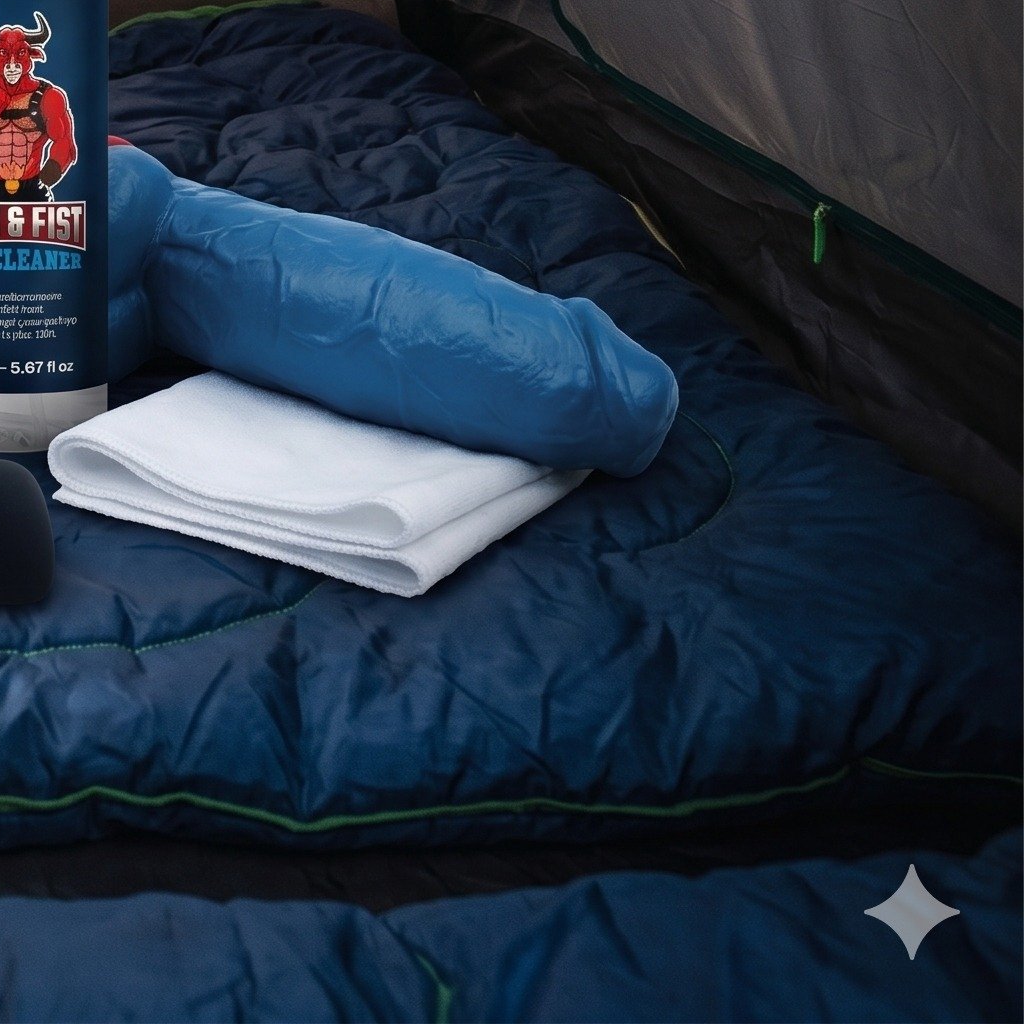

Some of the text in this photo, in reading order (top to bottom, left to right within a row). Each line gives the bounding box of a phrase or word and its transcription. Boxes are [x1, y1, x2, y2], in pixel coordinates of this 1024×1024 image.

[7, 206, 25, 237] &
[32, 205, 83, 243] FIST
[10, 361, 44, 375] 5.67
[47, 360, 56, 374] fl
[58, 361, 74, 373] oz
